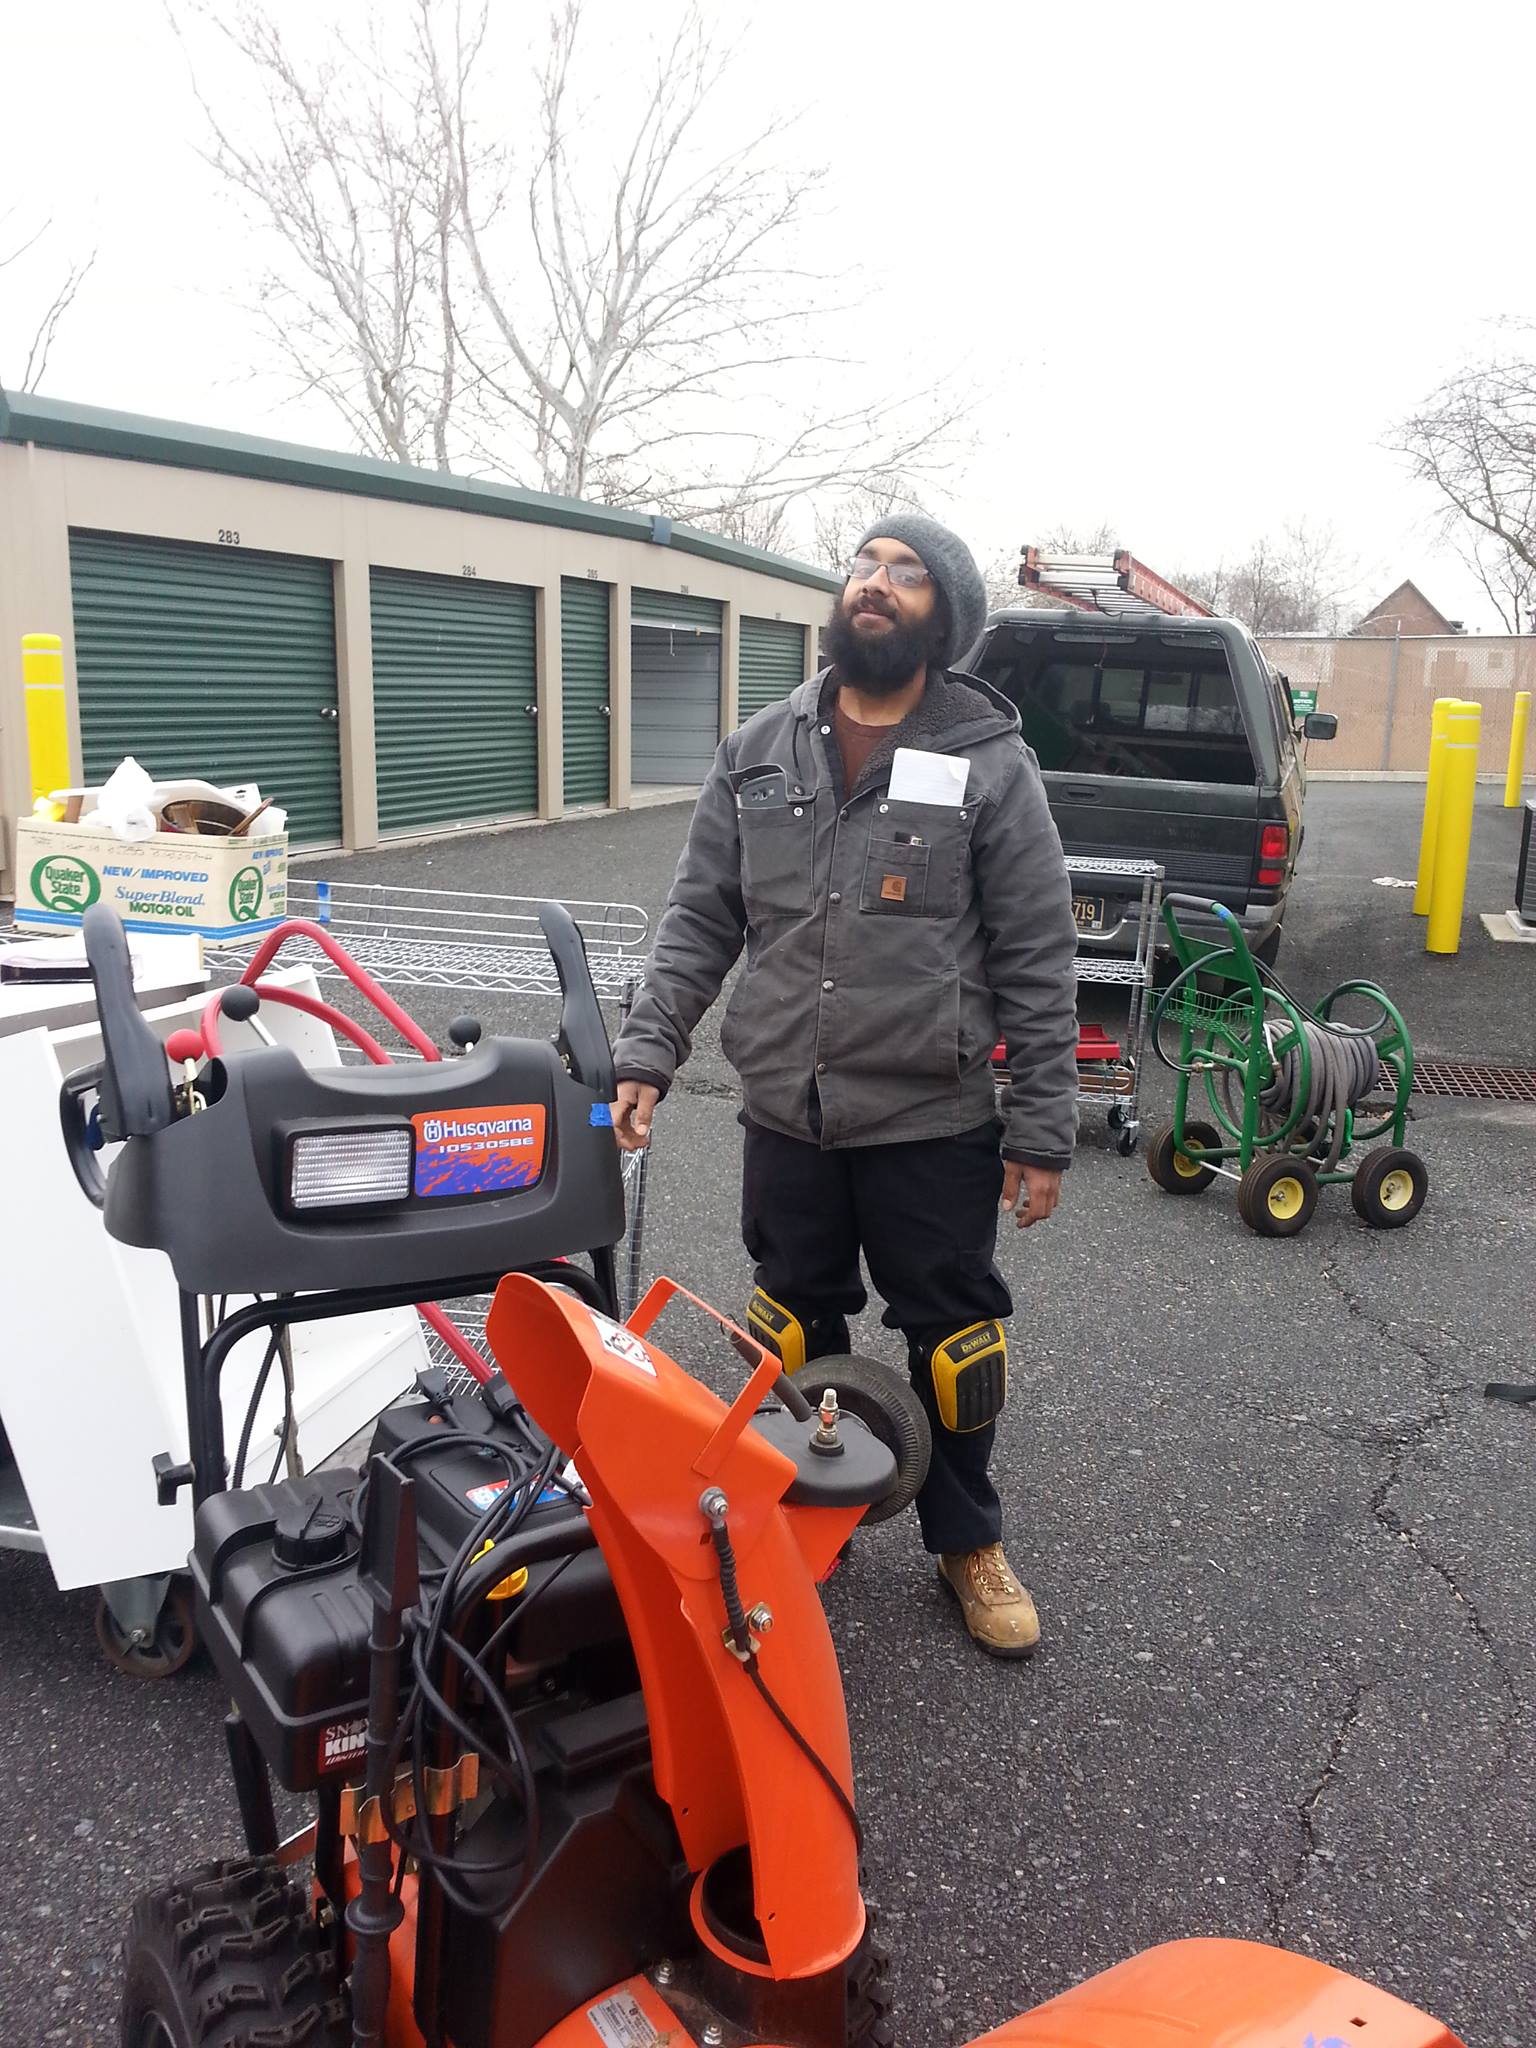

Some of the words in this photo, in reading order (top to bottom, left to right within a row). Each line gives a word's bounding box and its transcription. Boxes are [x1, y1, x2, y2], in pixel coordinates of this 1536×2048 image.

[218, 529, 240, 545] 283
[45, 865, 85, 883] Quaker
[50, 880, 82, 896] State
[129, 901, 174, 916] MOTOR
[174, 905, 196, 918] OIL
[1073, 902, 1096, 921] 719
[443, 1118, 533, 1138] Husqvarna
[325, 1718, 369, 1740] SNO
[325, 1732, 366, 1757] KIN
